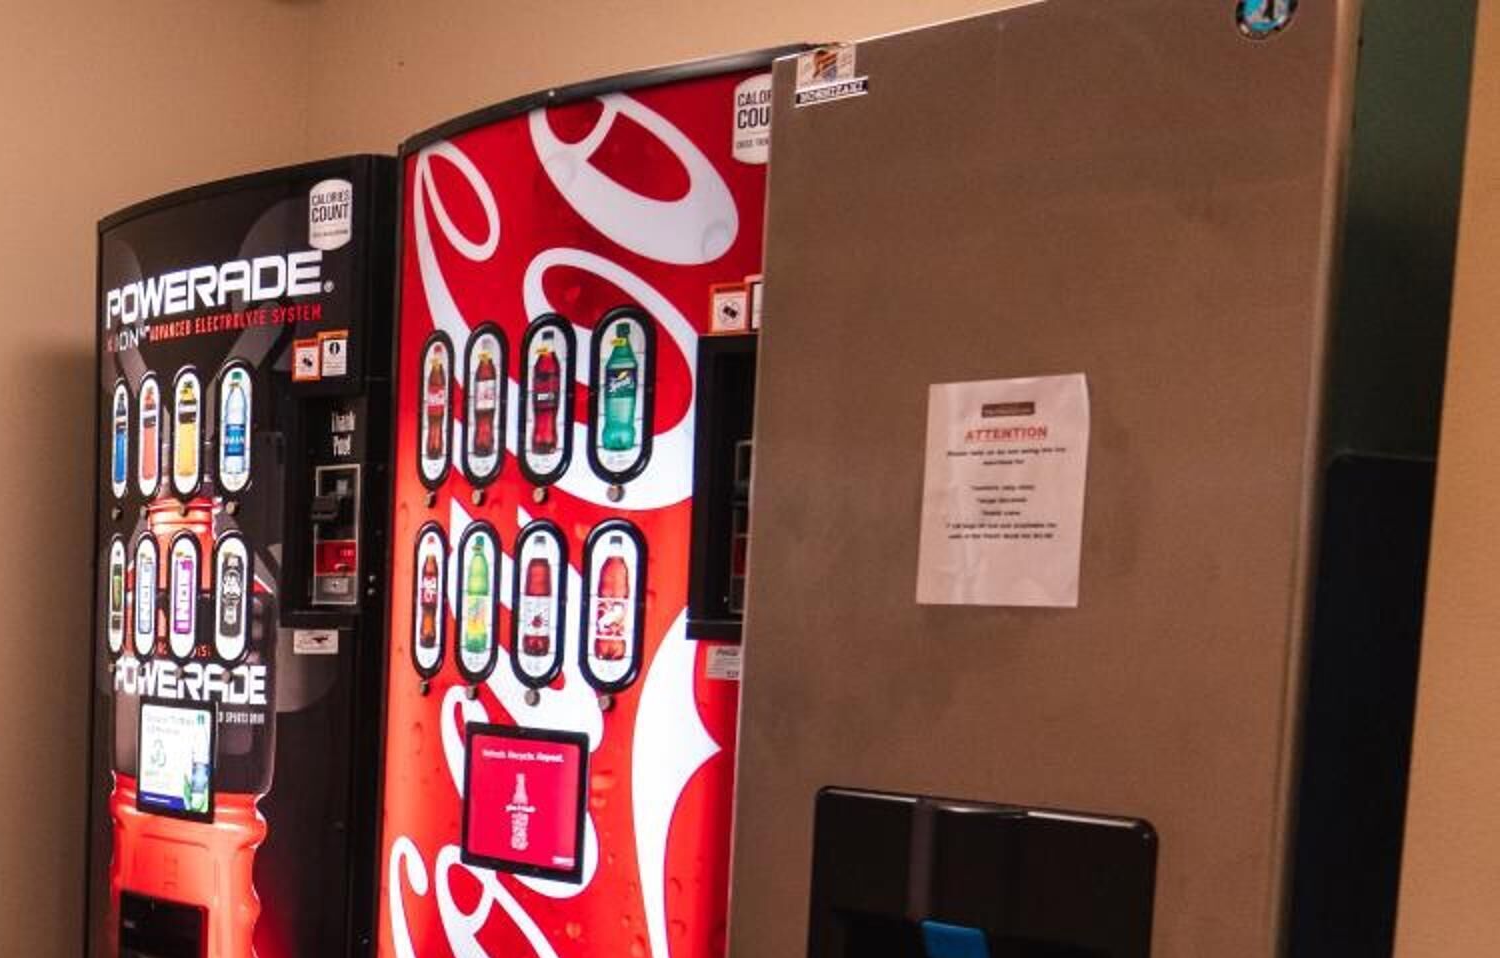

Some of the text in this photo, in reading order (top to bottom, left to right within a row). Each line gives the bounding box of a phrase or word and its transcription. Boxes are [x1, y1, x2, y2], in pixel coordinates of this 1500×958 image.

[738, 107, 770, 129] COU
[312, 188, 350, 206] CALORIES
[312, 202, 349, 223] COUNT
[106, 250, 323, 329] POWERADE
[150, 303, 322, 342] ADVANCED ELECTROLYTE SYSTEM
[965, 426, 1047, 441] ATTENTION
[114, 655, 267, 705] POWERADE
